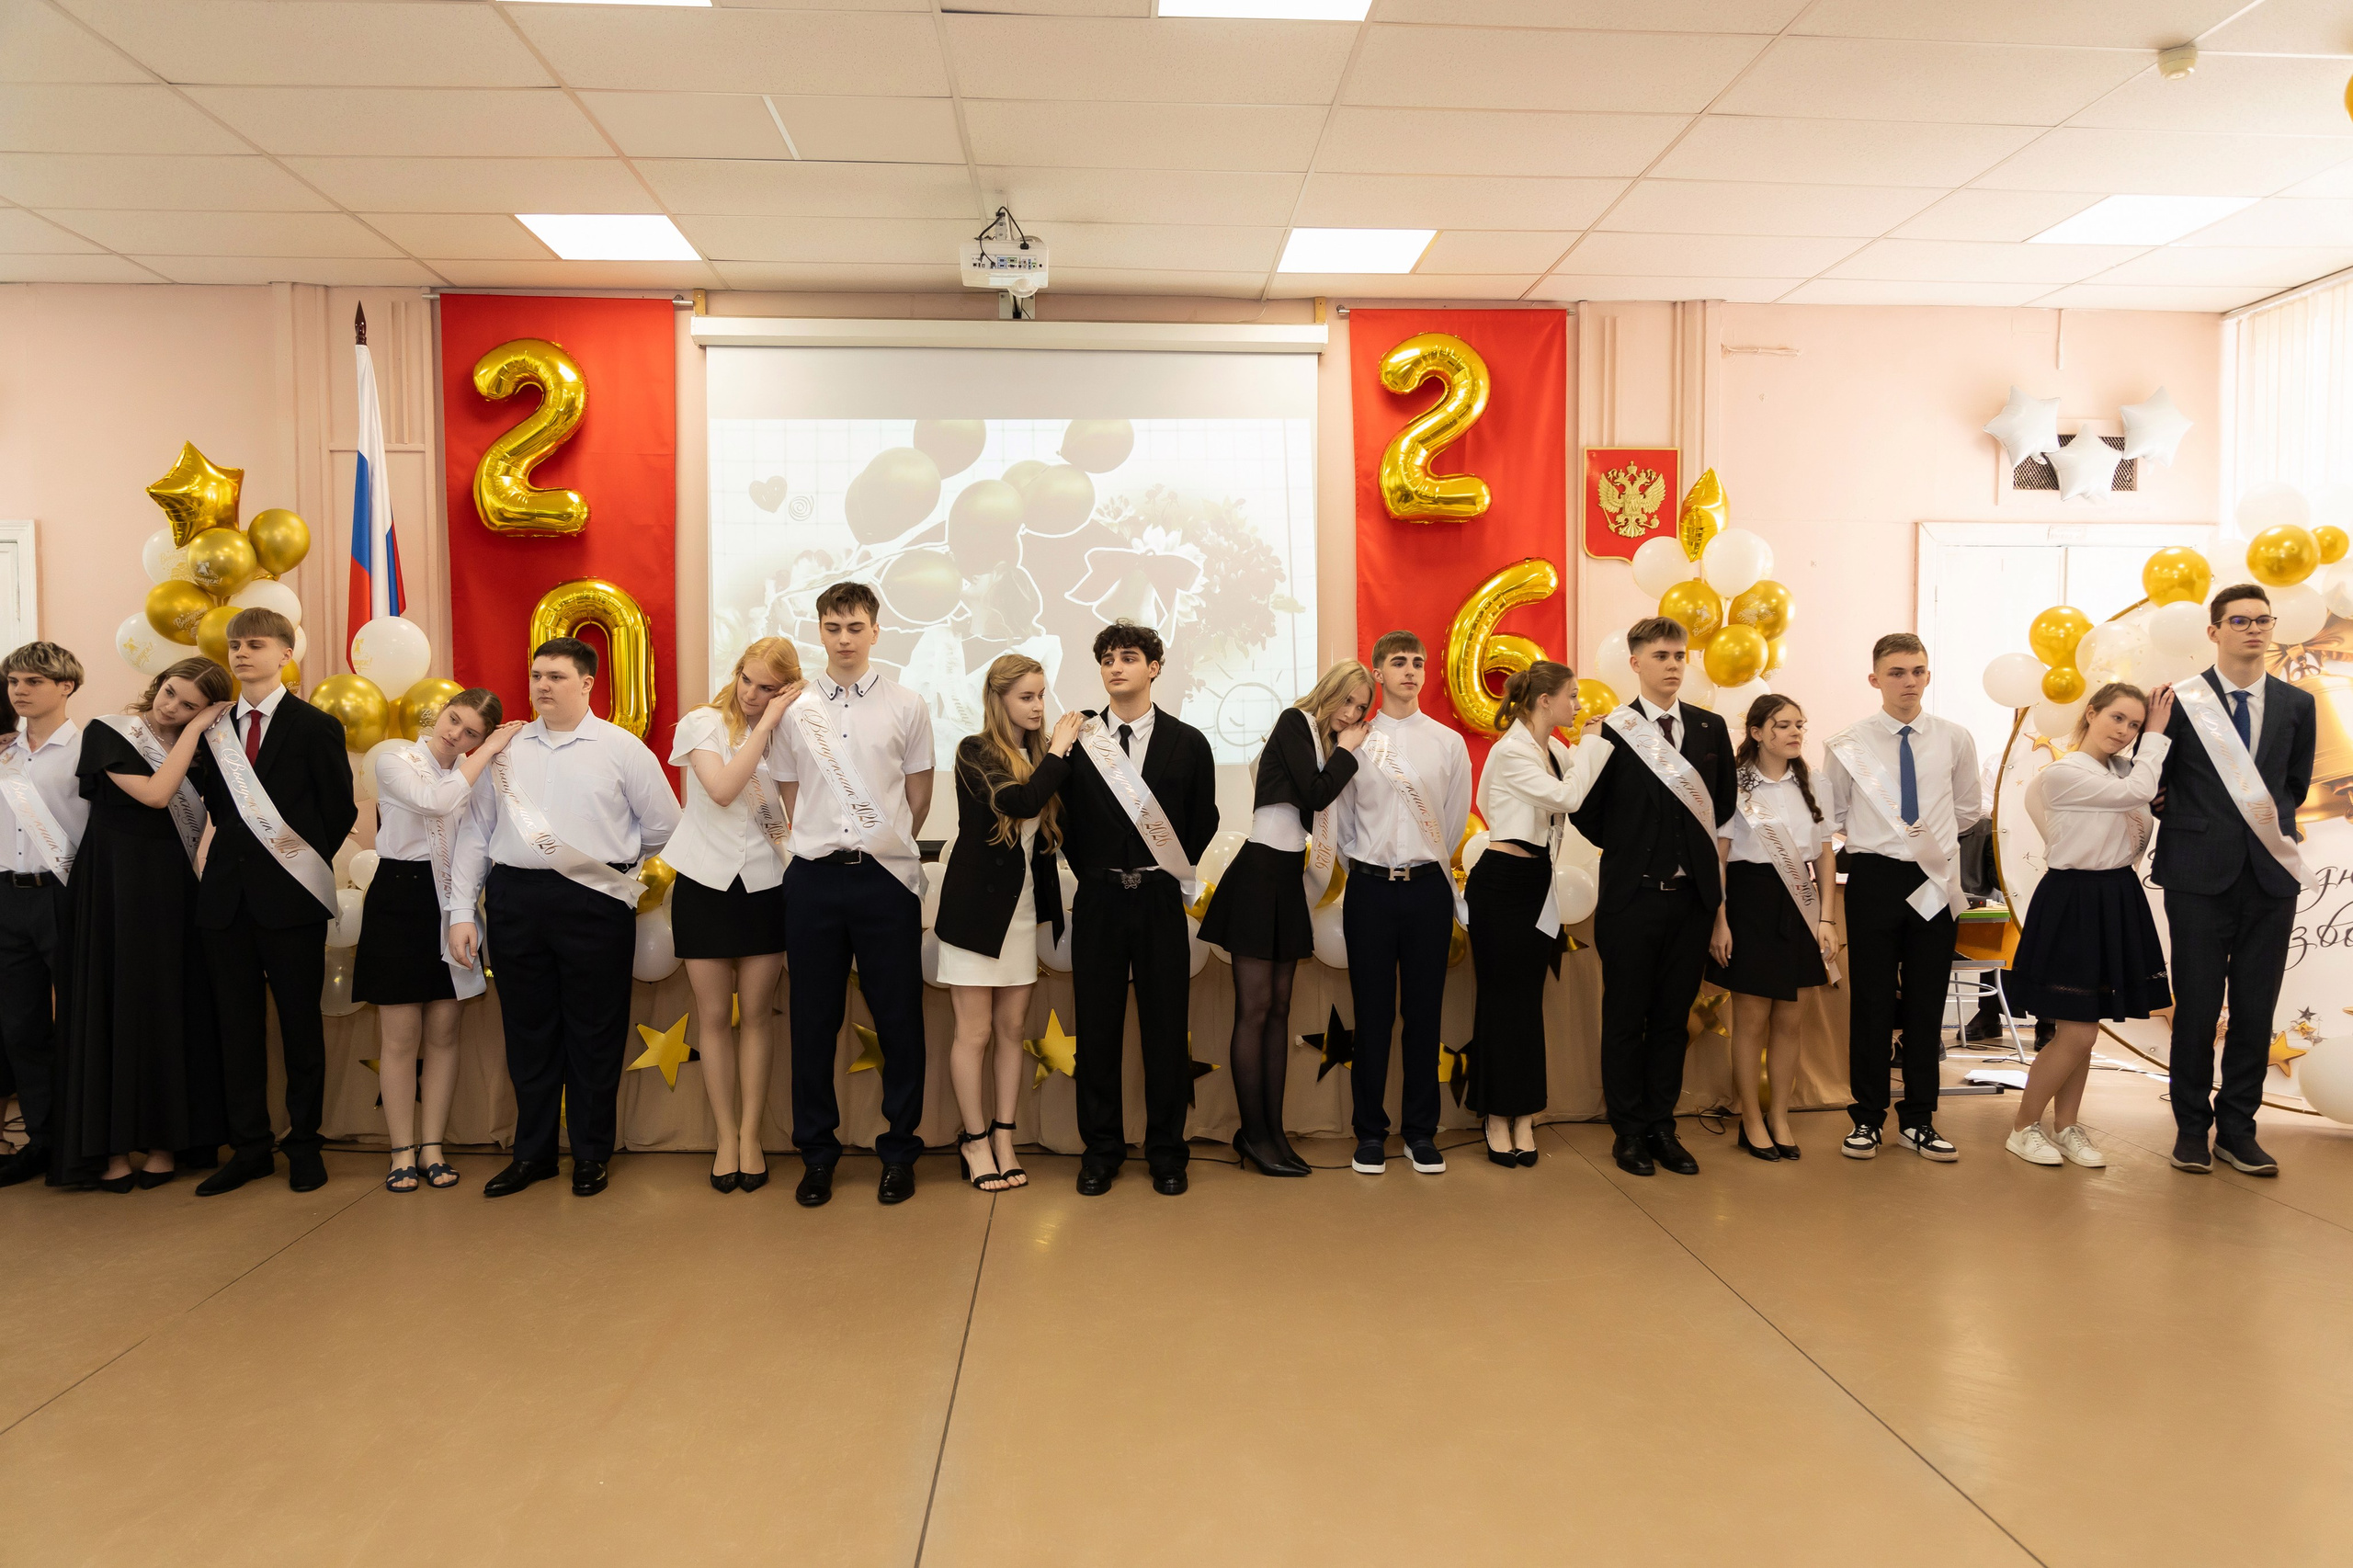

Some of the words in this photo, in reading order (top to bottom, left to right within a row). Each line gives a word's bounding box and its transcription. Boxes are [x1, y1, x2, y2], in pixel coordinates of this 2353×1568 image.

[472, 337, 590, 537] 2
[1379, 332, 1492, 524] 2
[1441, 557, 1559, 737] 6
[221, 747, 277, 835] Выпускник
[268, 834, 307, 860] 2026
[801, 709, 859, 800] Выпускник
[850, 801, 883, 829] 2026
[1089, 735, 1153, 820] Выпускник
[1143, 821, 1174, 847] 2026
[763, 821, 788, 845] 2026
[1314, 840, 1334, 870] 2026
[1794, 881, 1816, 907] 2026
